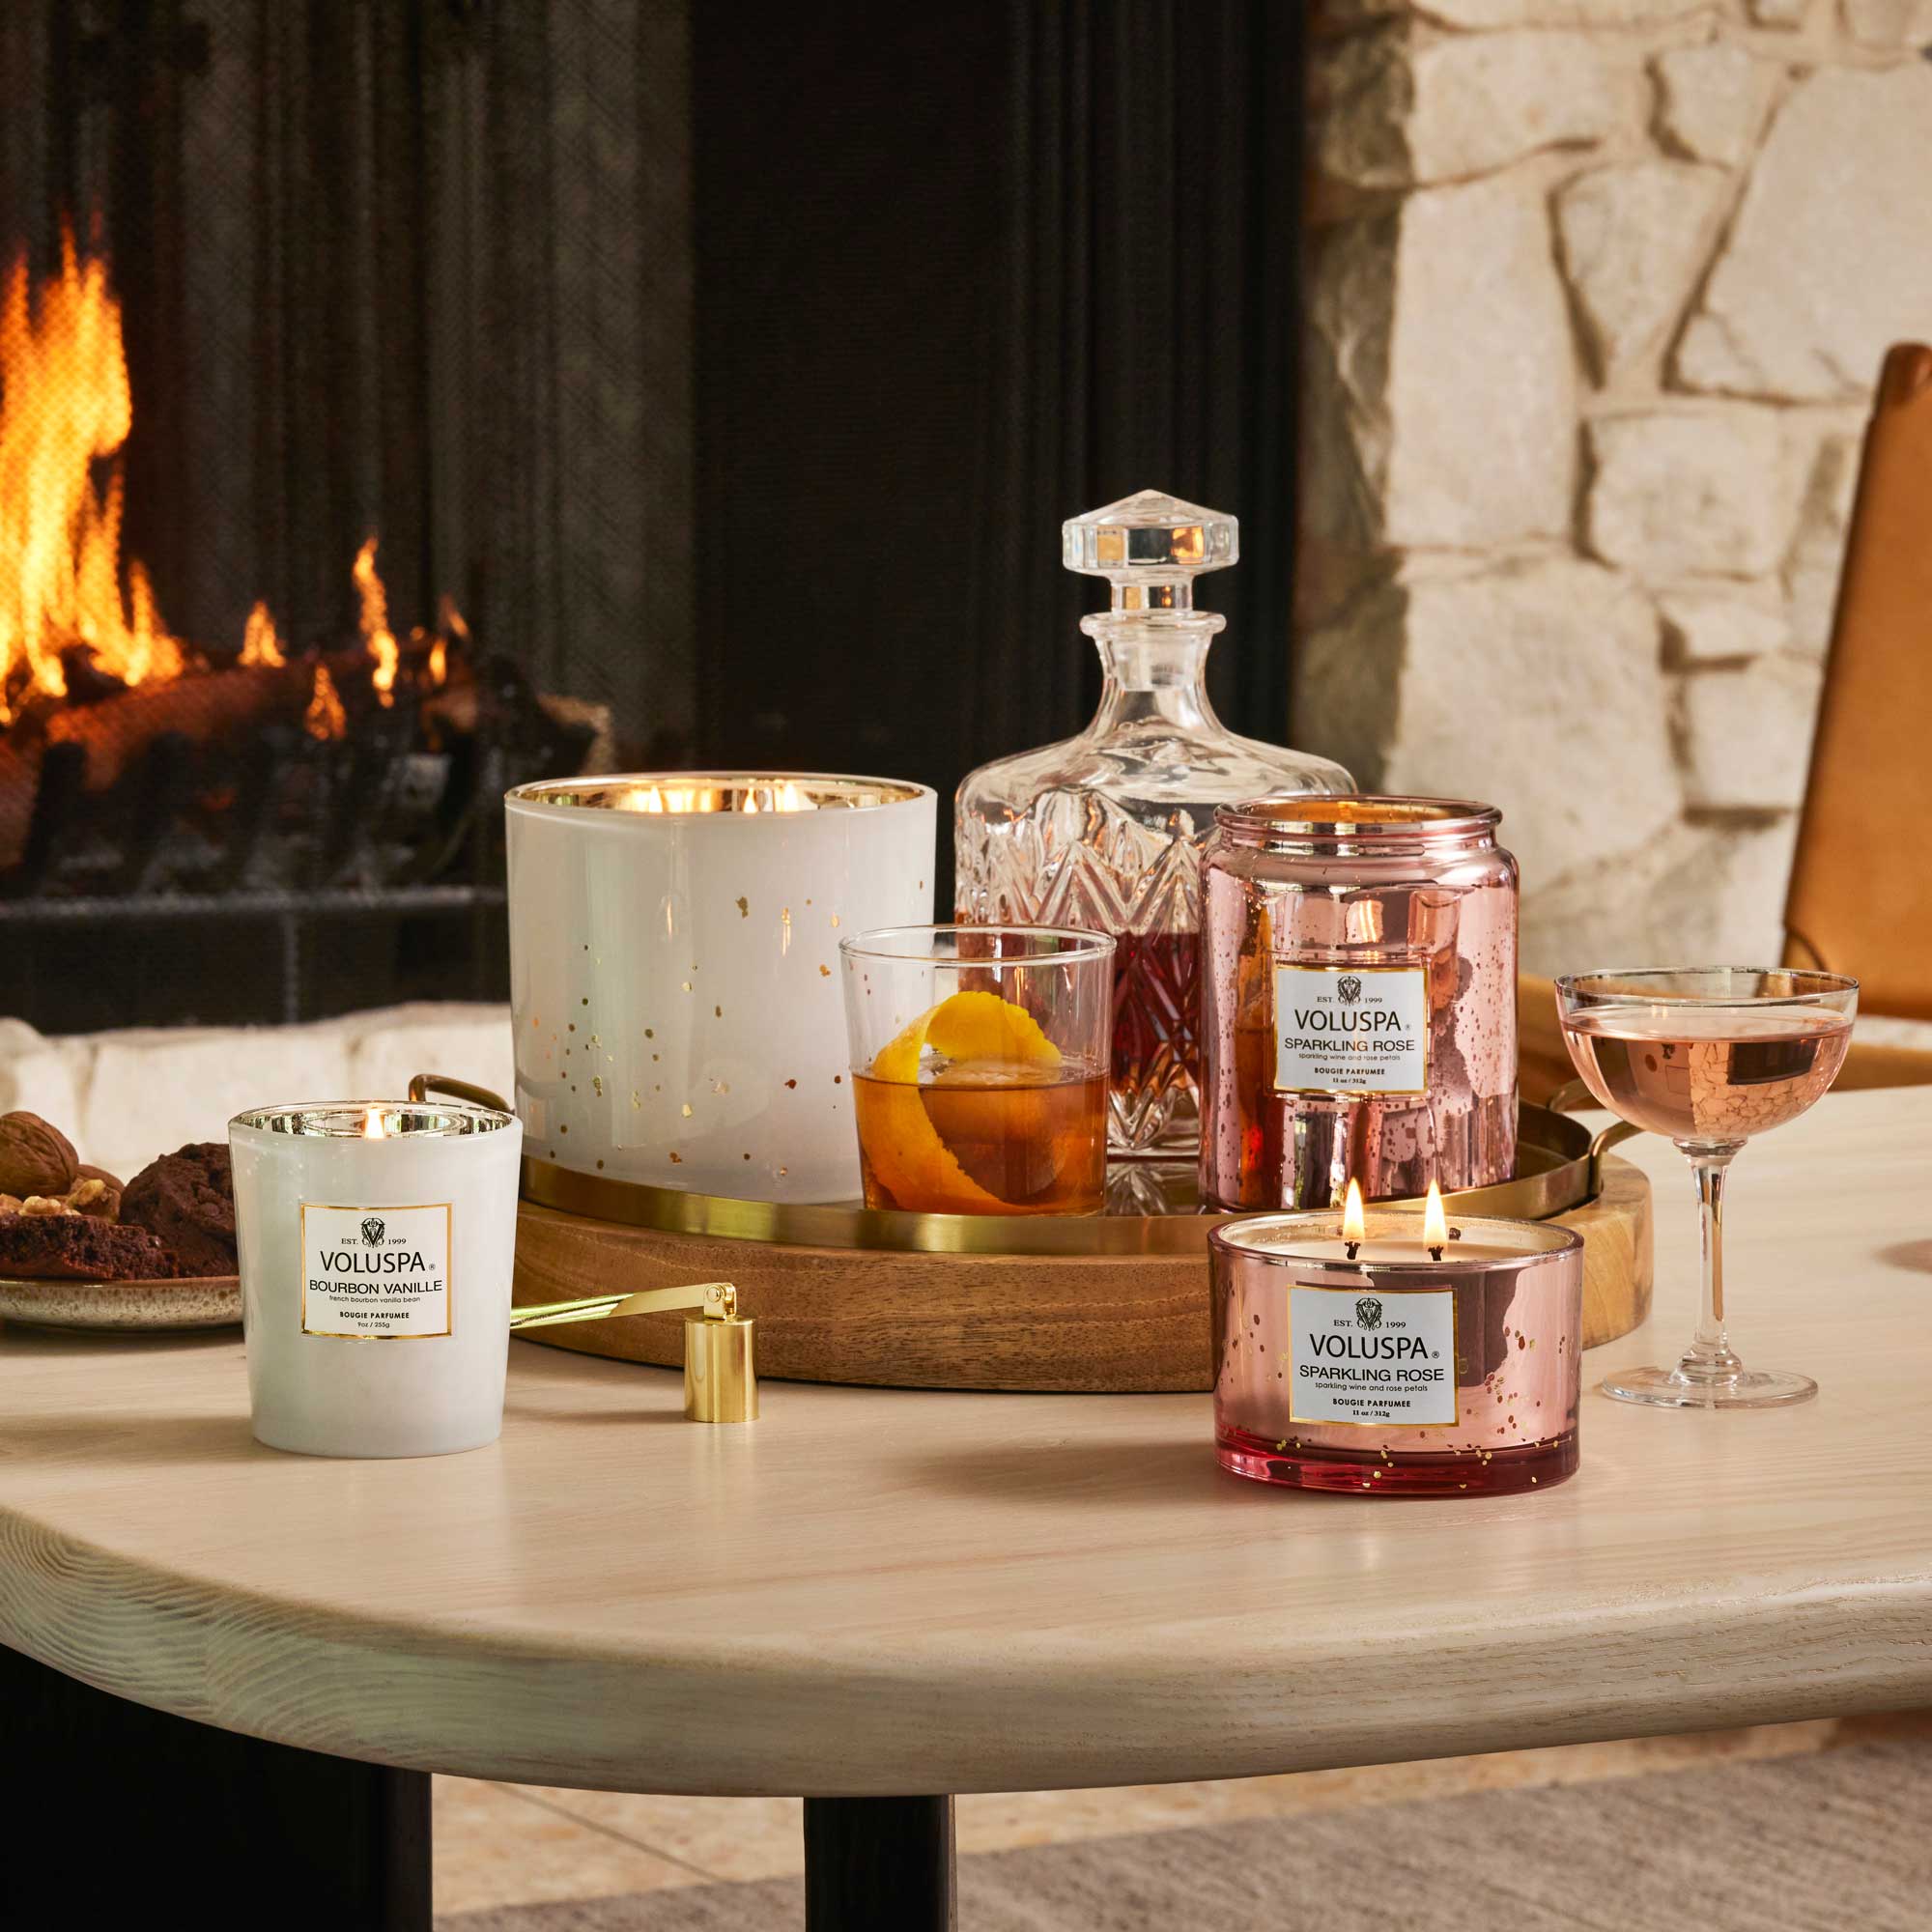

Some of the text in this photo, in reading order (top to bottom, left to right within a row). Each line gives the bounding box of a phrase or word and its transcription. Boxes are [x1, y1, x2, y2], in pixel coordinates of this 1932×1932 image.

[1294, 1009, 1402, 1032] VOLUSPA
[1285, 1038, 1415, 1052] SPARKLING ROSE
[320, 1251, 426, 1273] VOLUSPA
[310, 1280, 442, 1294] BOURBON VANILLE
[1310, 1334, 1429, 1359] VOLUSPA
[1300, 1365, 1444, 1381] SPARKLING ROSE
[1316, 1382, 1347, 1391] sparkling
